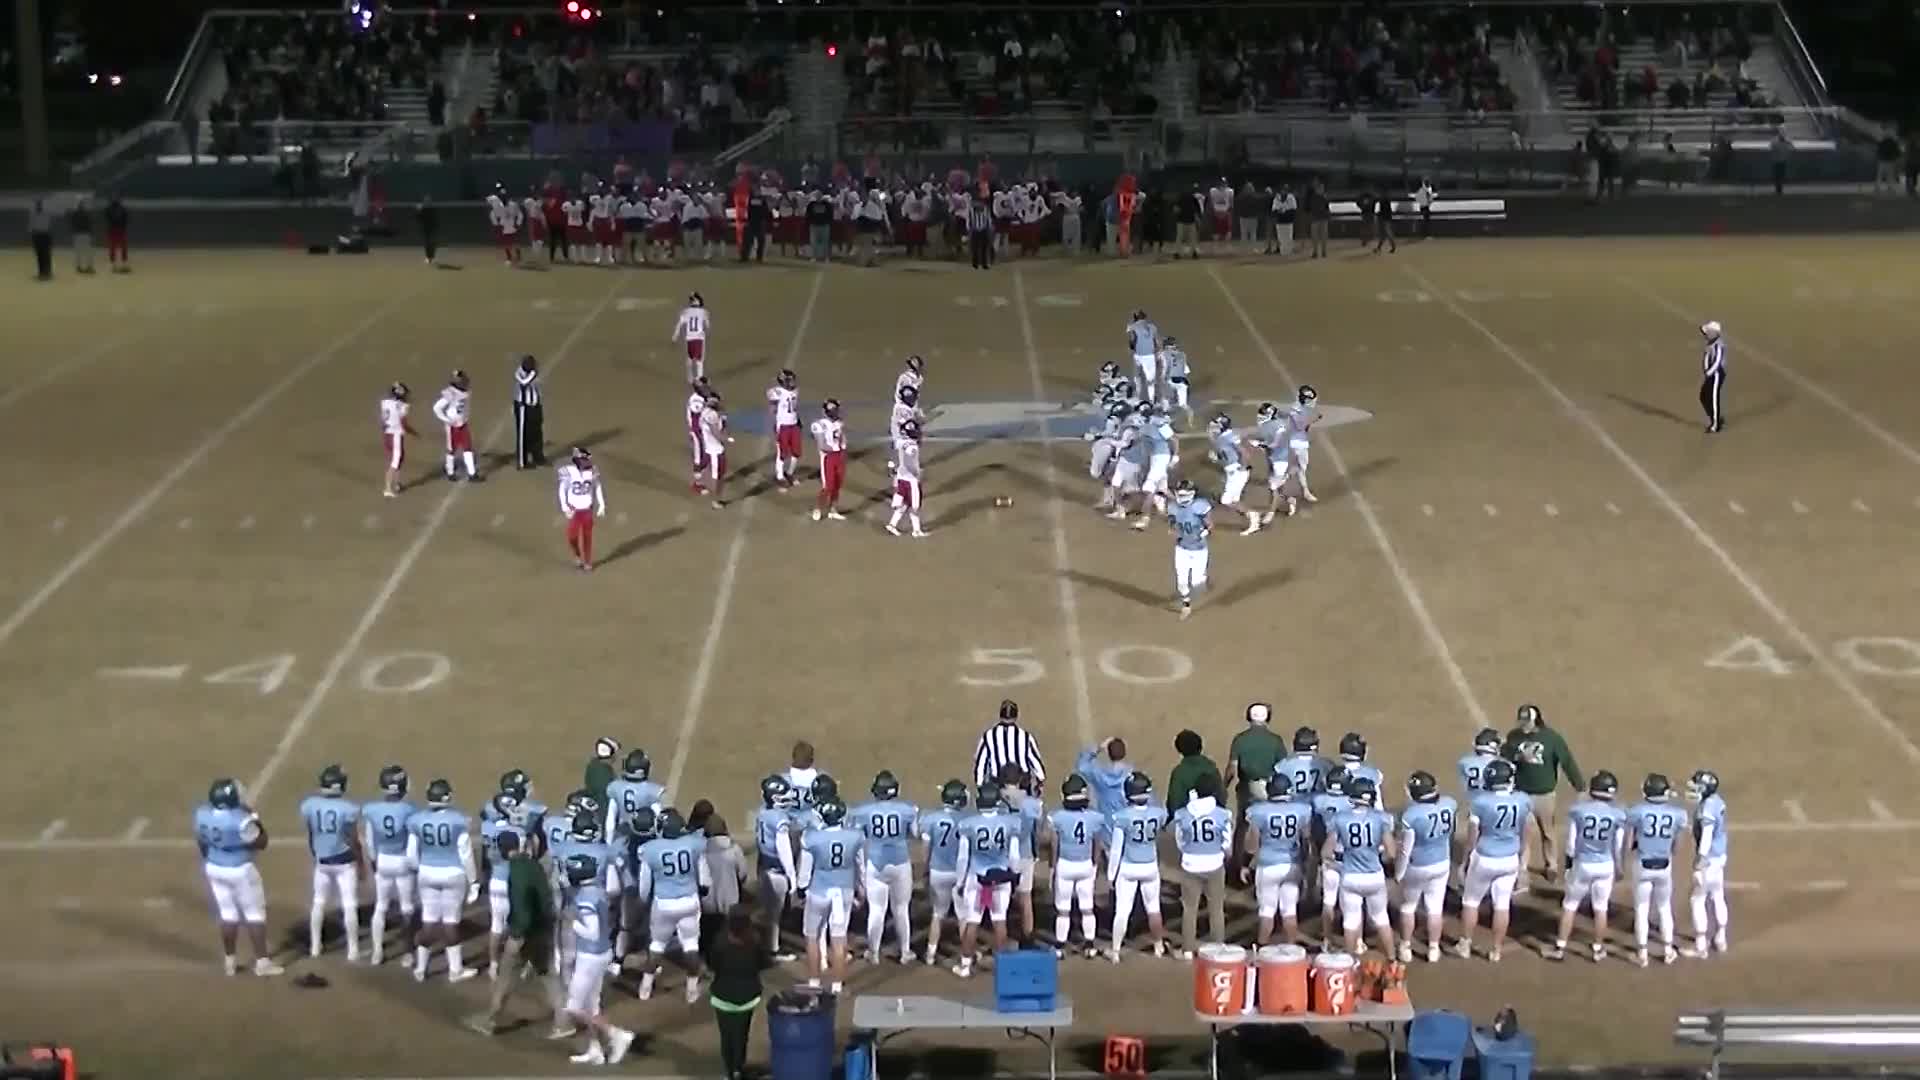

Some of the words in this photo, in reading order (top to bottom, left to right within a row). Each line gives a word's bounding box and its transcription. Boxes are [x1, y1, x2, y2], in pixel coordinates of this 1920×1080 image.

[1295, 768, 1320, 793] 27
[623, 789, 636, 813] 6
[316, 810, 337, 833] 13
[383, 815, 395, 839] 9
[872, 814, 899, 838] 80
[1270, 814, 1297, 838] 58
[1428, 809, 1451, 838] 79
[1495, 804, 1517, 829] 71
[1584, 815, 1612, 841] 22
[1645, 813, 1673, 839] 32
[422, 823, 450, 847] 60
[977, 827, 1004, 851] 24
[1074, 820, 1085, 847] 4
[1132, 818, 1157, 842] 33
[1191, 819, 1215, 842] 16
[1349, 822, 1373, 848] 81
[662, 849, 691, 877] 50
[831, 842, 843, 867] 8
[1108, 1040, 1140, 1072] 50
